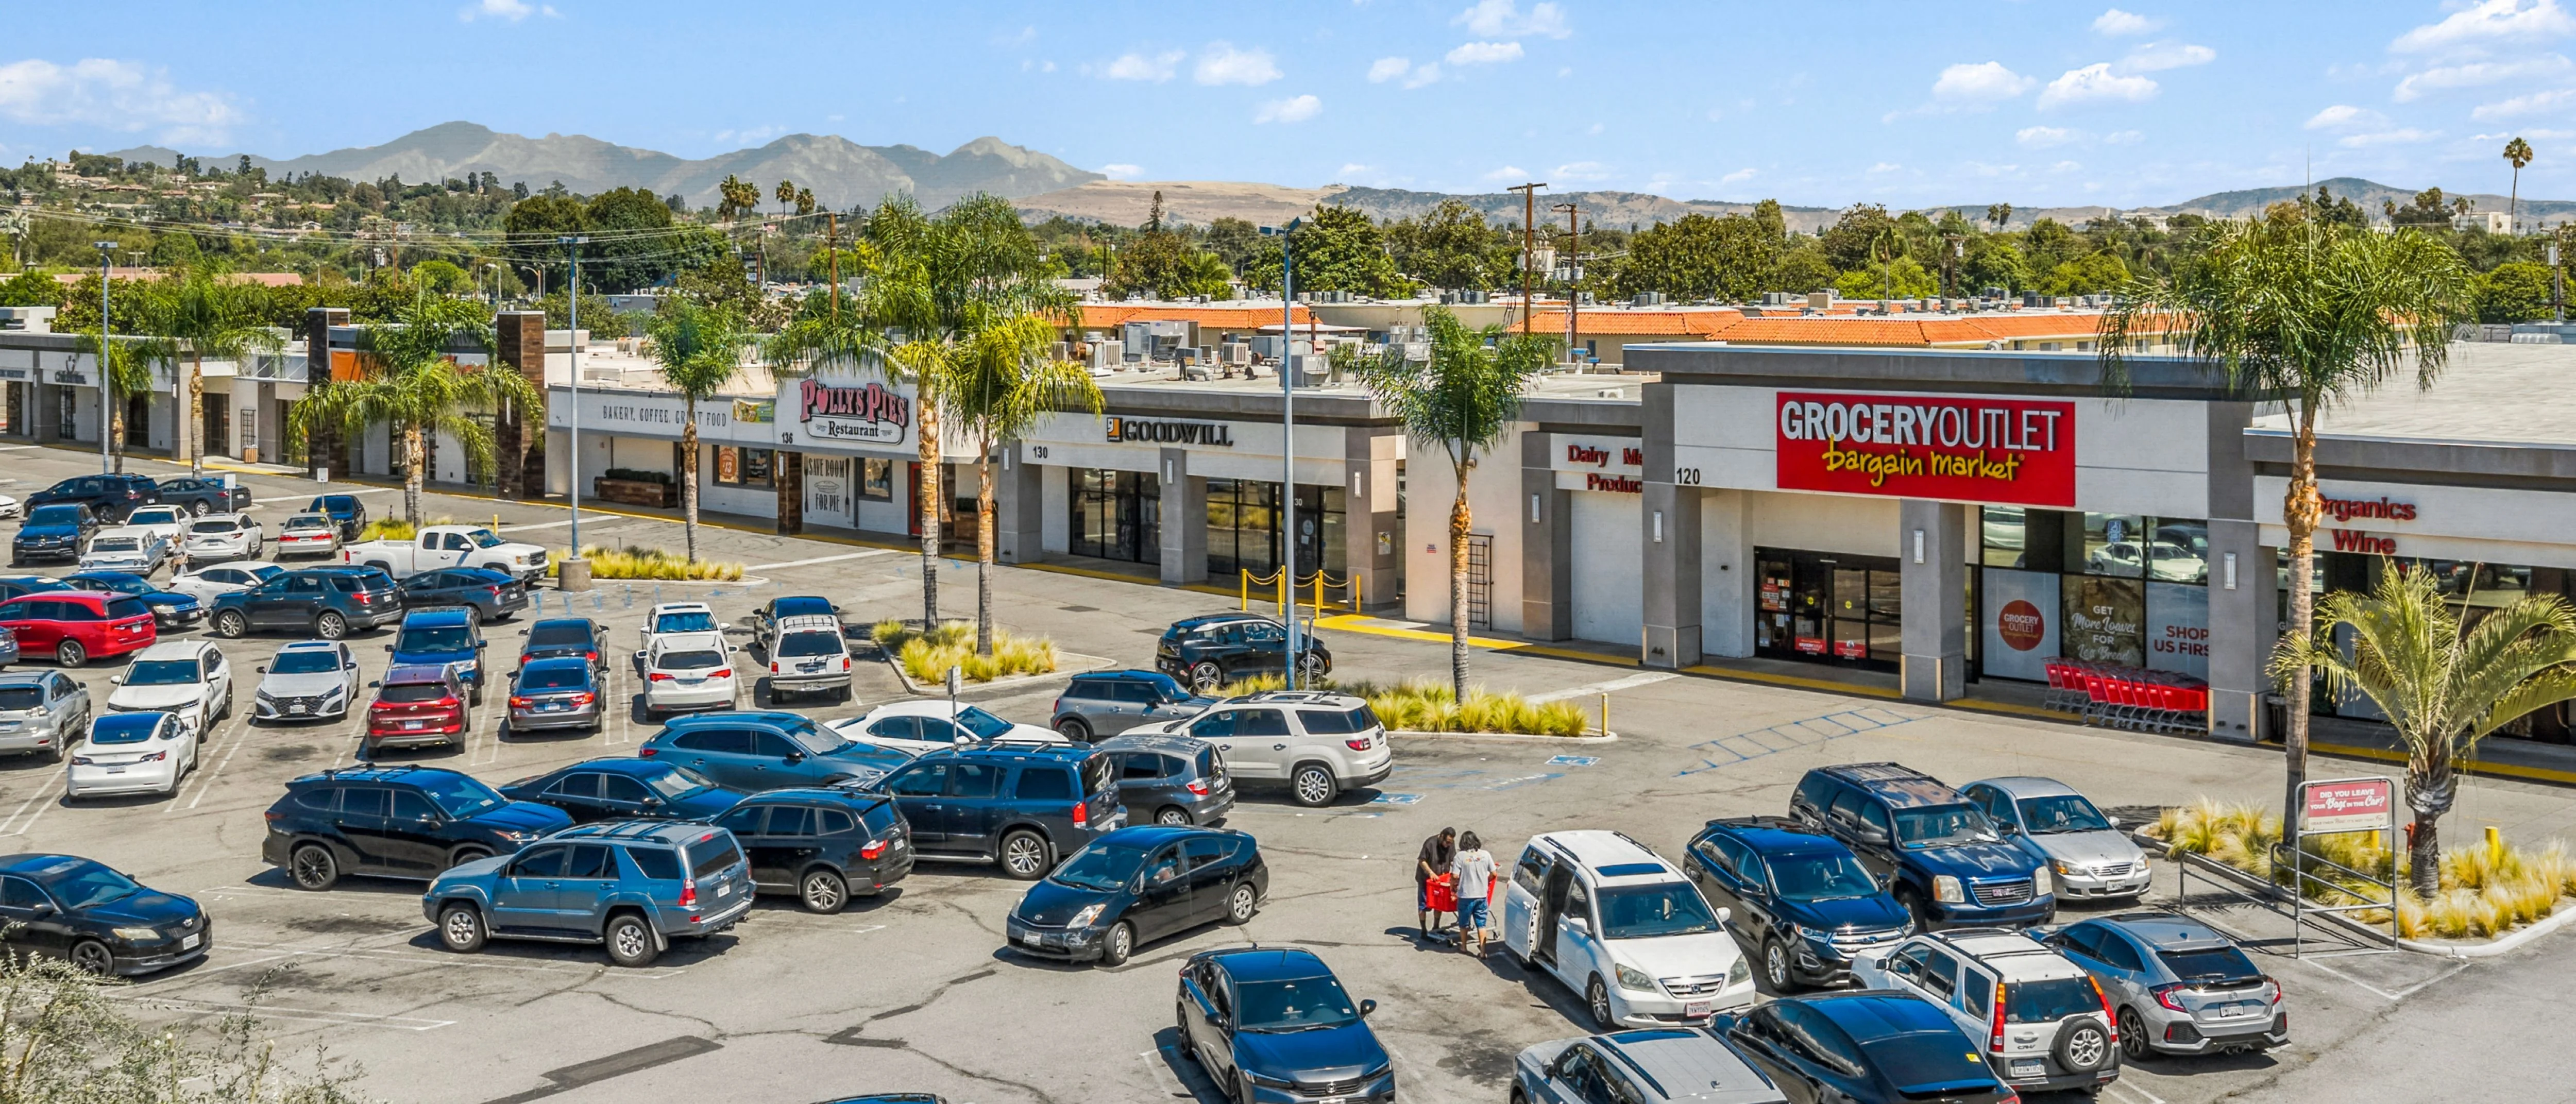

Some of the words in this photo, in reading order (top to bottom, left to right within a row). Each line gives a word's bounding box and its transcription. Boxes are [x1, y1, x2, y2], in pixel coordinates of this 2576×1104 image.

[866, 383, 908, 428] PIES
[675, 410, 702, 426] GRT
[706, 413, 726, 427] FOOD
[828, 421, 879, 437] Restaurant
[1122, 421, 1233, 447] GOODWILL
[782, 432, 793, 444] 136
[1032, 446, 1048, 458] 130
[1568, 445, 1610, 468] Dairy
[808, 457, 824, 477] SAVE
[825, 458, 845, 478] ROOM
[1822, 434, 1923, 487] bargain
[1931, 449, 2019, 481] market
[1676, 467, 1700, 484] 120
[815, 493, 828, 511] FOR
[829, 495, 840, 512] PIE
[2331, 529, 2396, 554] Wine
[2093, 605, 2113, 615] GET
[2004, 613, 2039, 624] GROCERY
[2072, 613, 2101, 630] More
[2009, 622, 2033, 633] OUTLET
[2165, 625, 2208, 640] SHOP
[2093, 634, 2114, 644] FOR
[2154, 639, 2175, 653] US
[2097, 646, 2130, 661] Bread
[2326, 797, 2346, 811] Bags
[2365, 795, 2385, 807] Car?
